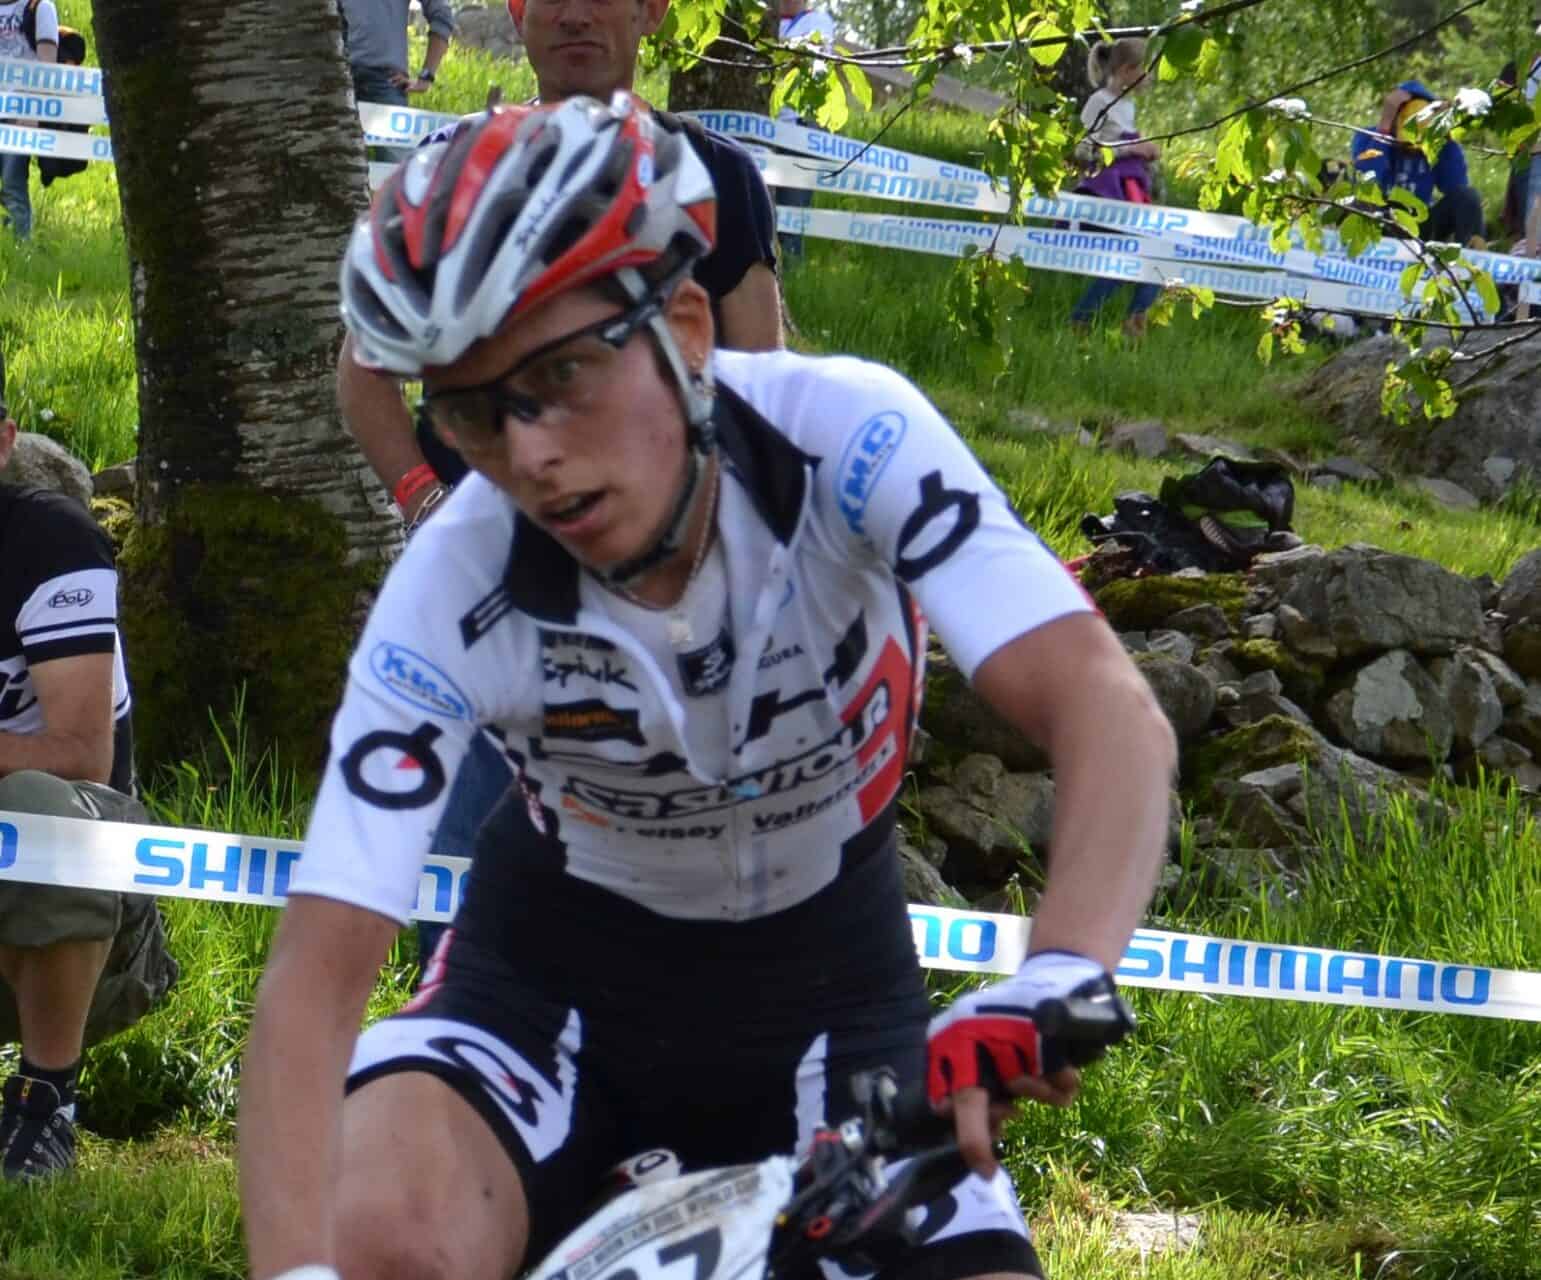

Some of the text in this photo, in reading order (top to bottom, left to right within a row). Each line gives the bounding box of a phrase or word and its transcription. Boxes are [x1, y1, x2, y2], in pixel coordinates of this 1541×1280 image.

[807, 132, 910, 172] SHIMANO
[1026, 231, 1140, 254] SHIMANO
[1116, 936, 1493, 1006] SHIMANO
